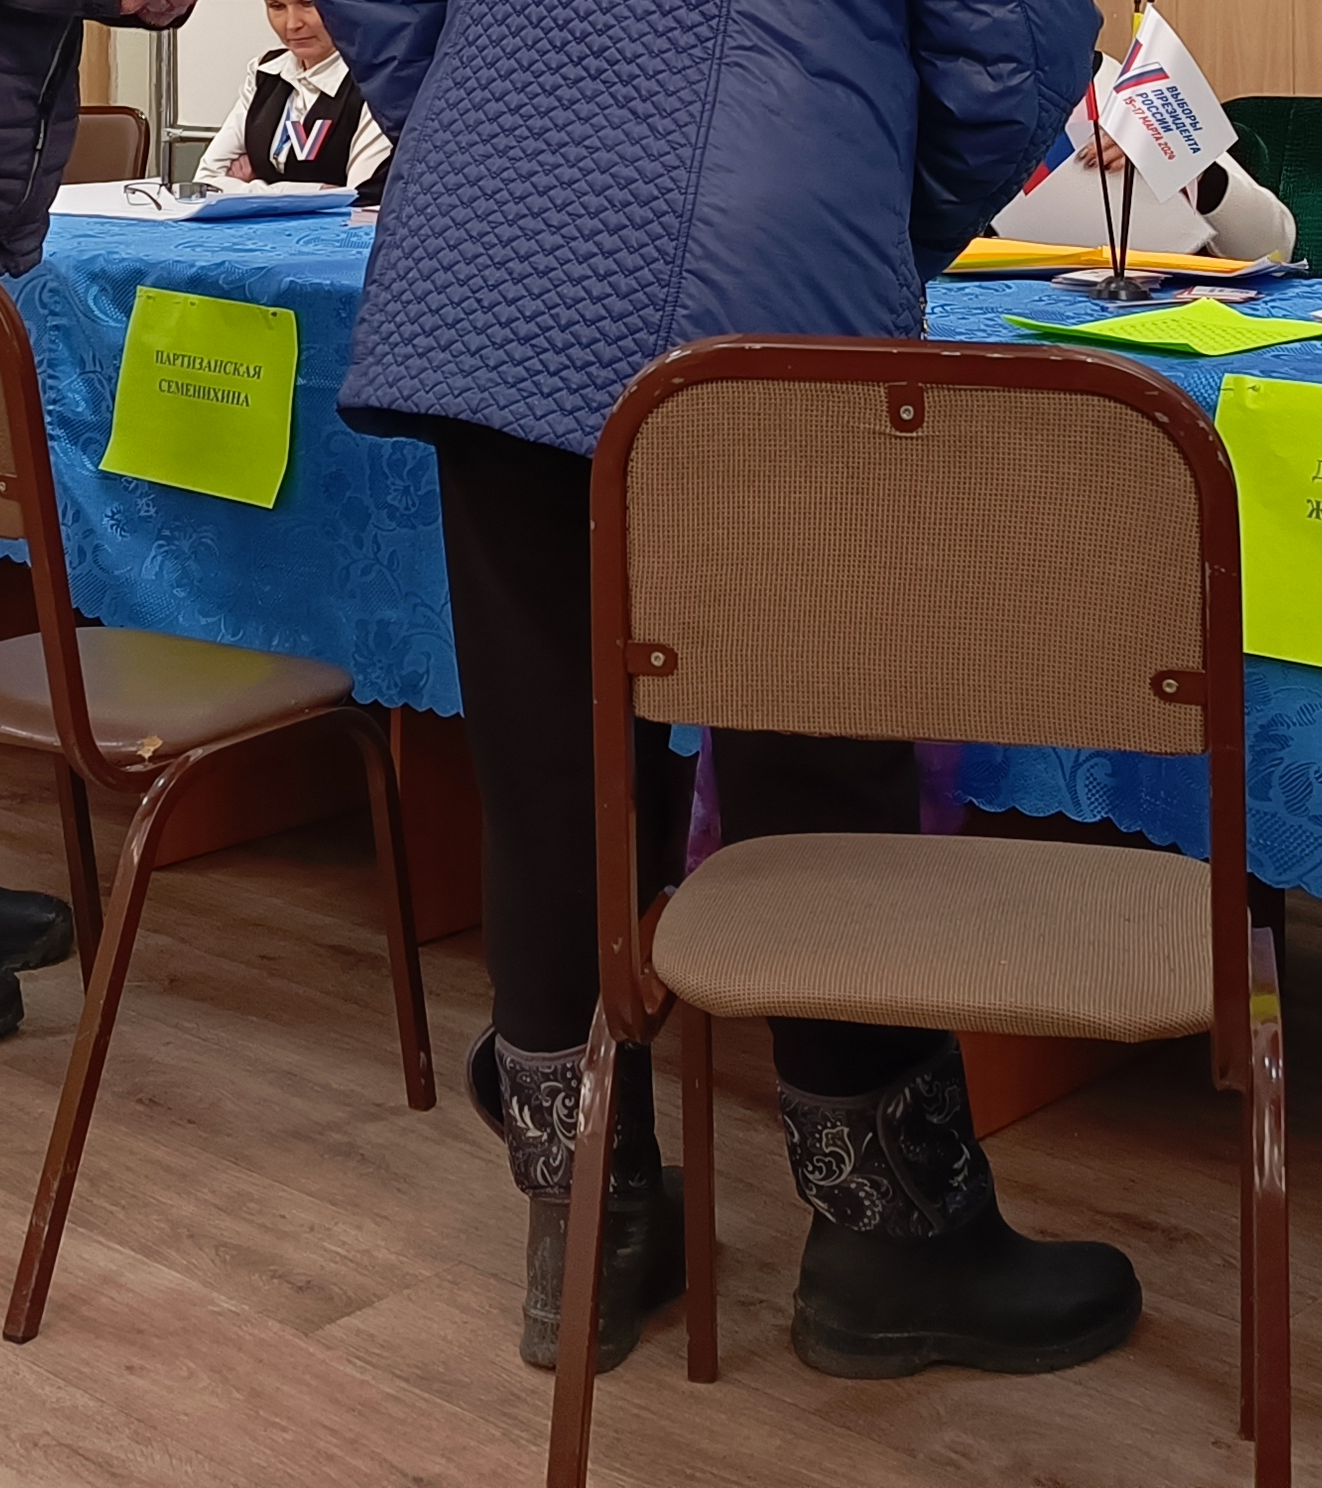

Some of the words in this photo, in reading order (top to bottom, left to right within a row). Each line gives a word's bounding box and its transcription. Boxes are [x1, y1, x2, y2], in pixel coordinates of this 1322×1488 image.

[1136, 92, 1174, 133] РОССИИ
[1151, 89, 1201, 154] ПРЕЗИДЕНТА
[1166, 86, 1203, 132] ВЫБОРЫ
[1139, 116, 1163, 142] МАРТА
[1158, 141, 1176, 161] 2024
[155, 349, 263, 380] ПАРТИЗАНСКАЯ
[158, 378, 250, 408] СЕМЕНИХИНА
